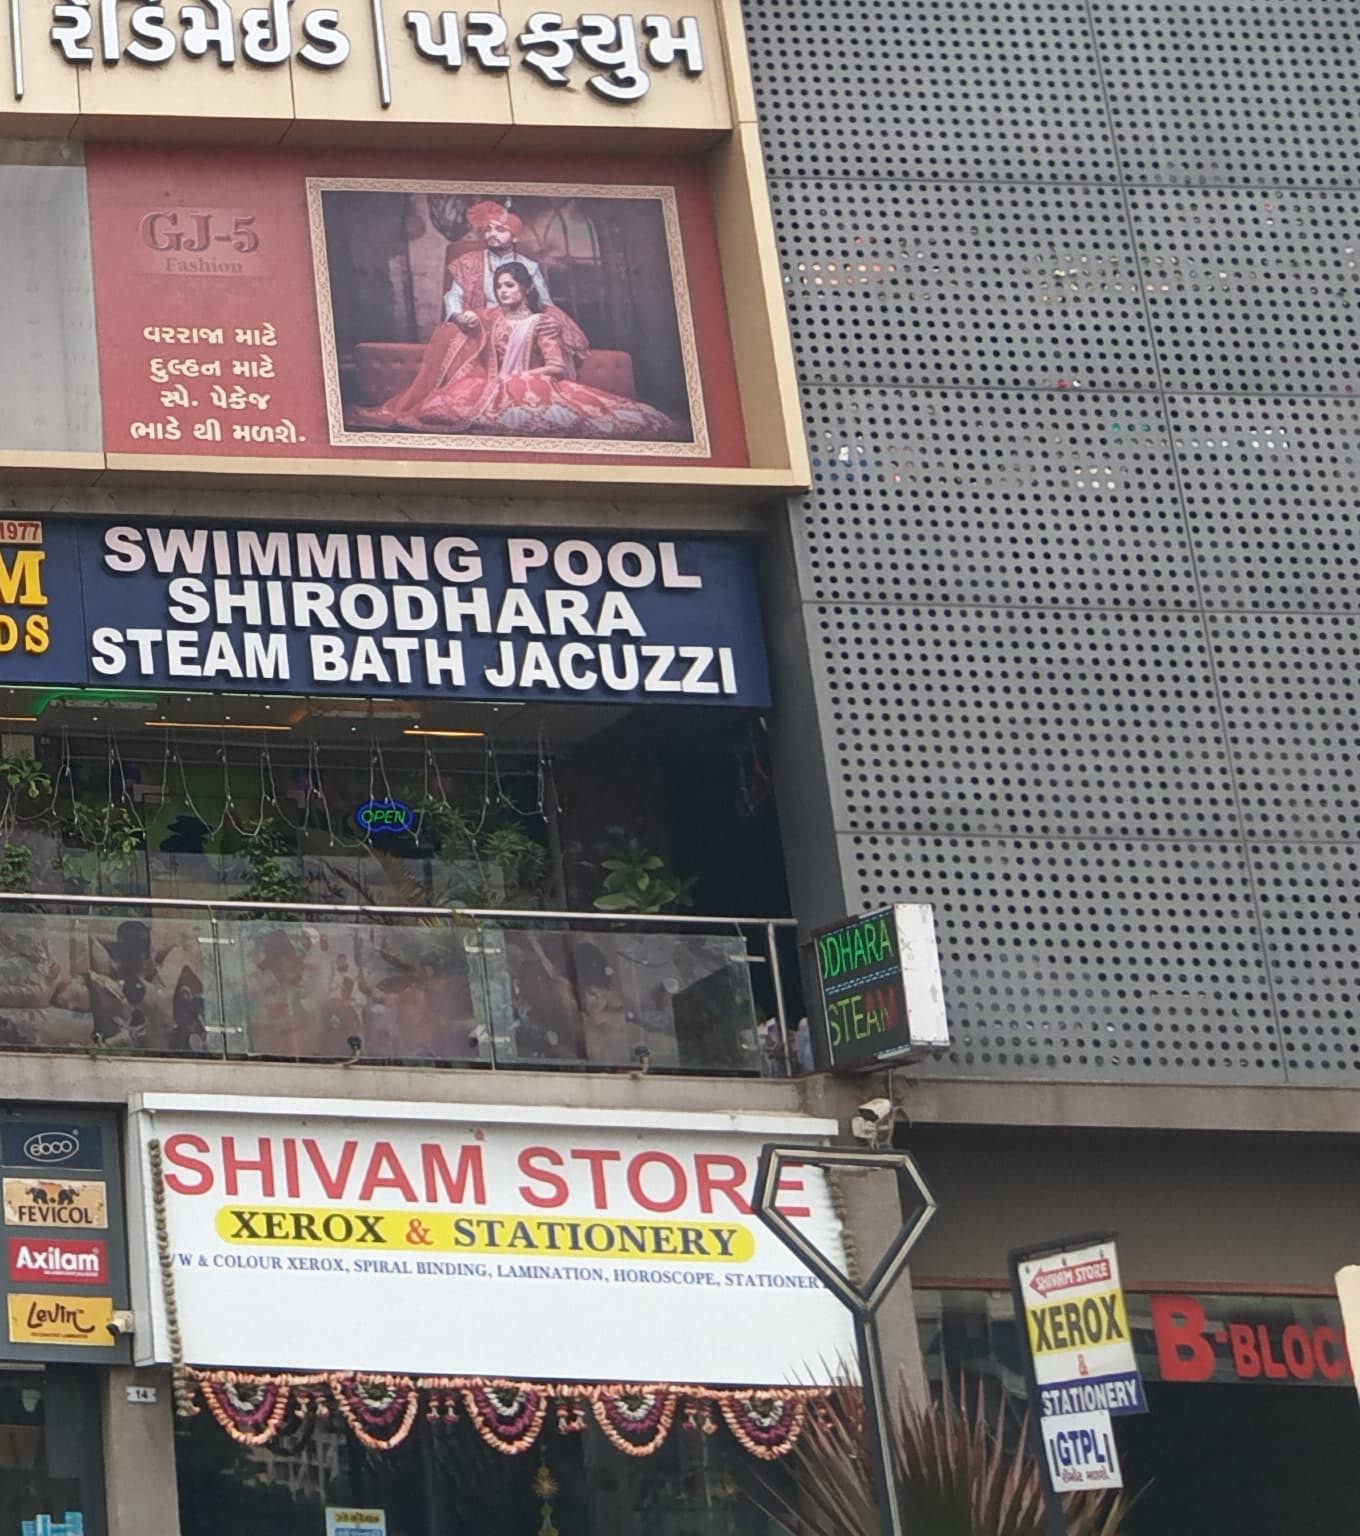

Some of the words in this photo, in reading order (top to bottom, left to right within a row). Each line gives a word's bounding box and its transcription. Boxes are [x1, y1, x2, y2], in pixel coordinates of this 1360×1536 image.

[103, 525, 482, 583] SWIMMING
[508, 539, 702, 588] POOL
[169, 578, 646, 637] SHIRODHARA
[91, 628, 291, 680] STEAM
[309, 635, 465, 686] BATH
[485, 641, 736, 694] JACUZZI
[361, 808, 406, 826] OPEN
[164, 1133, 486, 1205] SHIVAM
[517, 1146, 812, 1217] STORE
[18, 1206, 93, 1224] FEVICOL
[230, 1210, 384, 1243] XEROX
[404, 1218, 430, 1246] &
[454, 1219, 738, 1256] STATIONERY
[17, 1246, 99, 1271] Axilam
[213, 1255, 283, 1269] COLOUR
[287, 1257, 350, 1272] XEROX,
[353, 1259, 412, 1274] SPIRAL
[417, 1262, 493, 1278] BINDING,
[497, 1265, 610, 1283] LAMINATION,
[613, 1269, 721, 1286] HOROSCOPE,
[1030, 1294, 1124, 1351] XEROX
[1042, 1379, 1139, 1416] STATIONERY
[1055, 1428, 1106, 1466] GTPL
